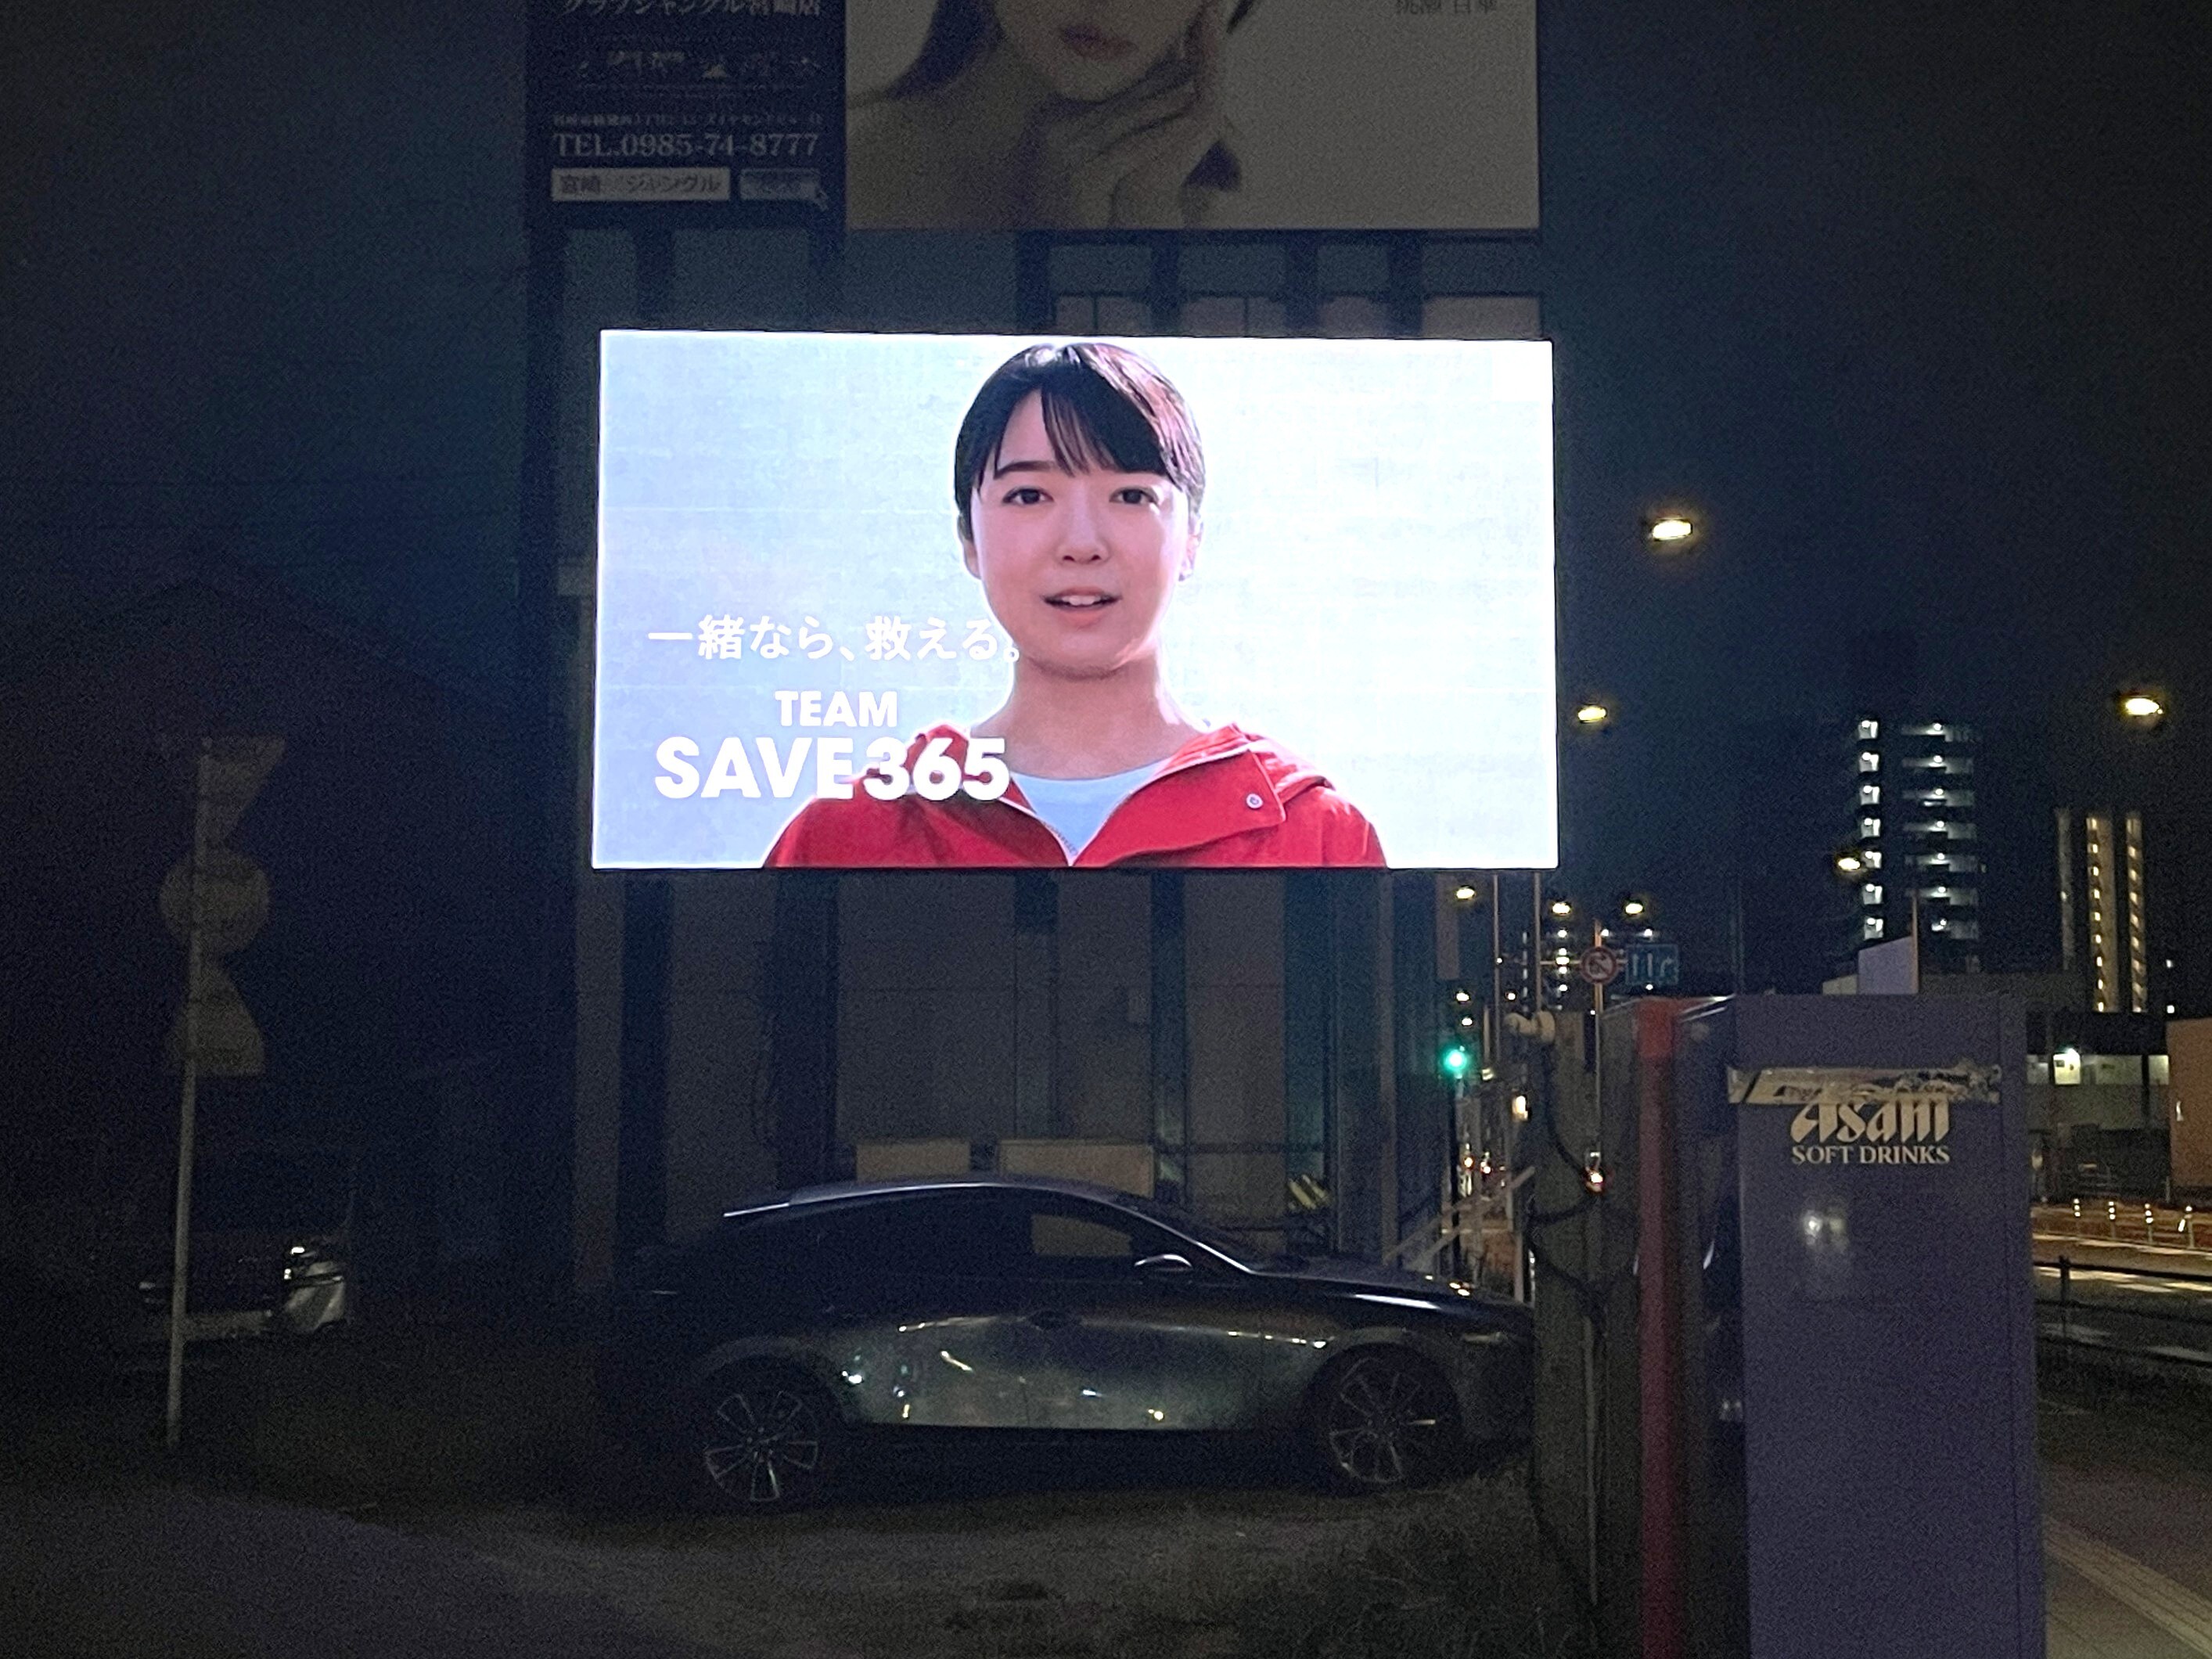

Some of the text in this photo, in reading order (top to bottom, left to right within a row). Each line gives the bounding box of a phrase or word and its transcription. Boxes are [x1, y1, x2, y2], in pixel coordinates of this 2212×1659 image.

[647, 614, 1020, 663] 一緒なら、救える。
[775, 690, 898, 728] TEAM
[1791, 1145, 1951, 1164] SOFT DRINKS
